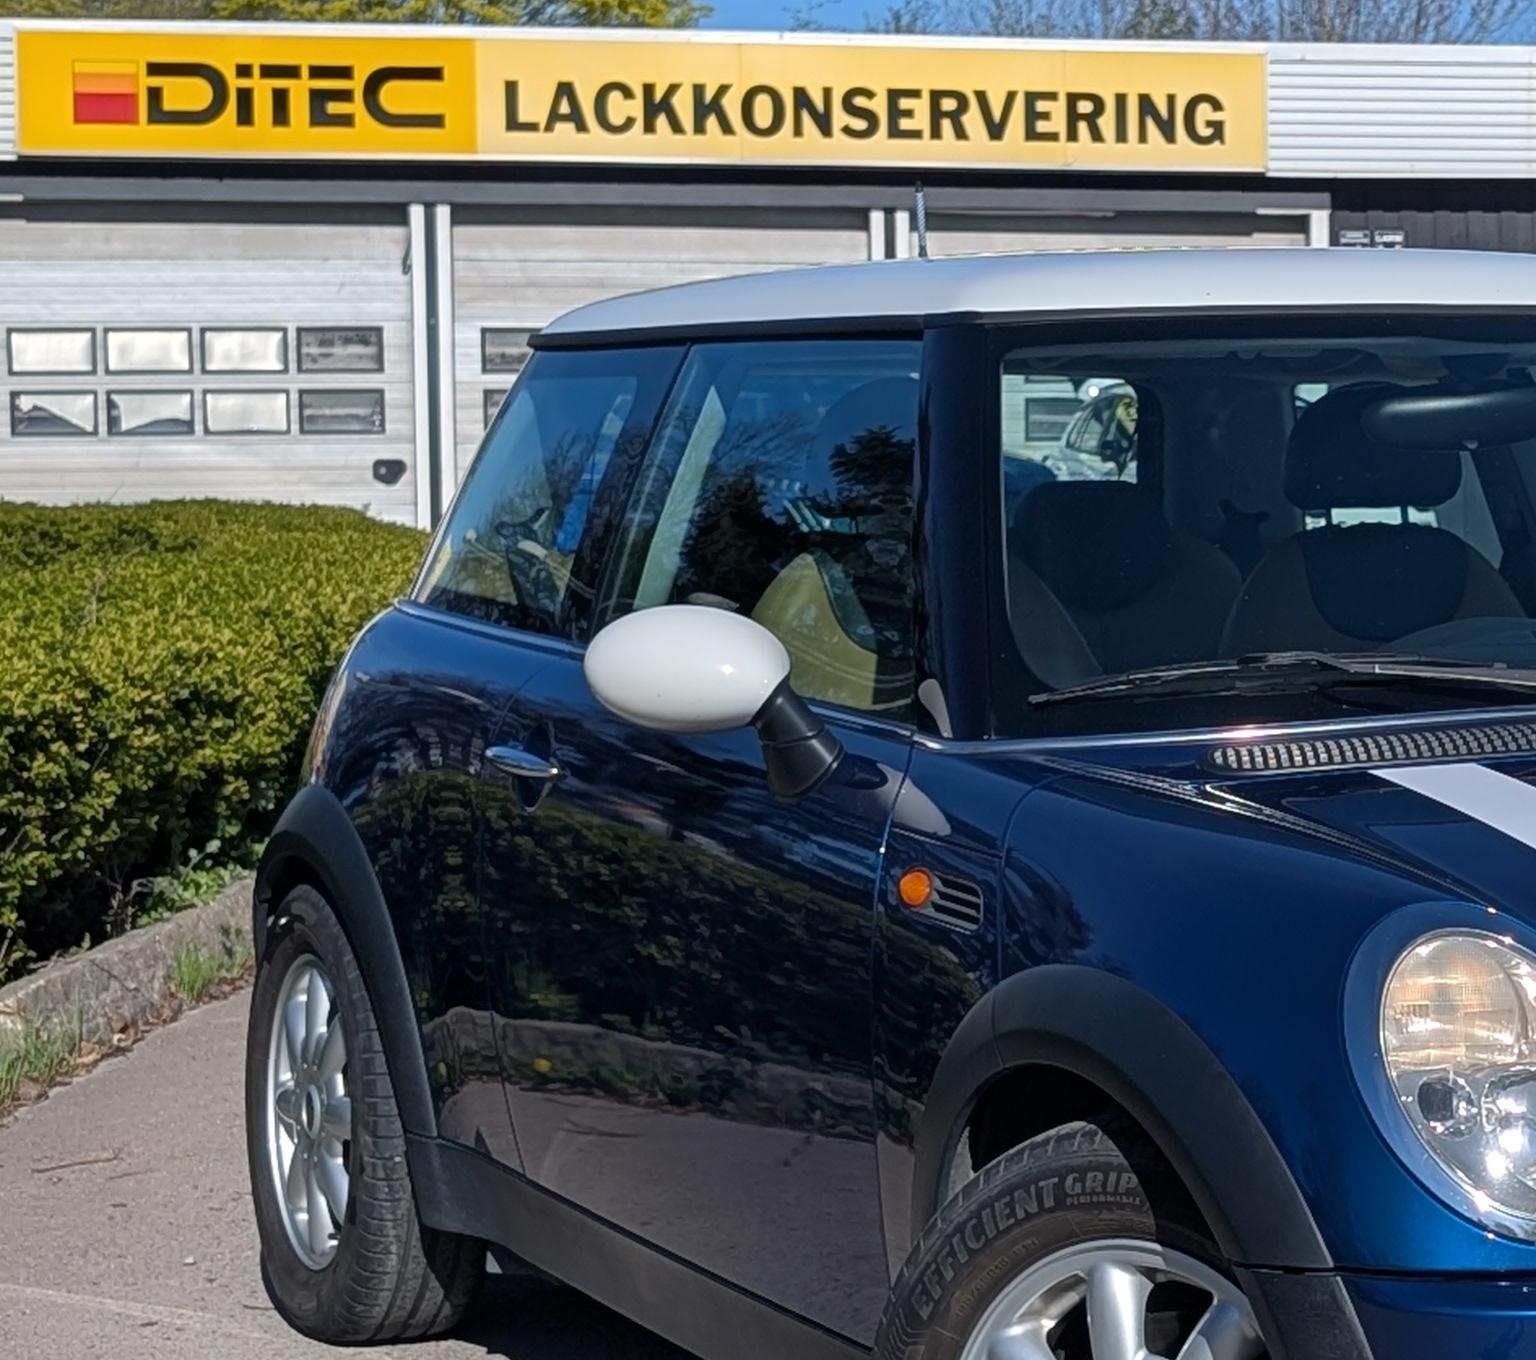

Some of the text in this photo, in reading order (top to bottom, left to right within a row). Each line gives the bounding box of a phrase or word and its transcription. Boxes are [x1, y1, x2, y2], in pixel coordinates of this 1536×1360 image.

[503, 80, 1226, 146] LACKKONSERVERING
[910, 1177, 1059, 1320] EFFICIENT
[1064, 1171, 1138, 1195] GRIP
